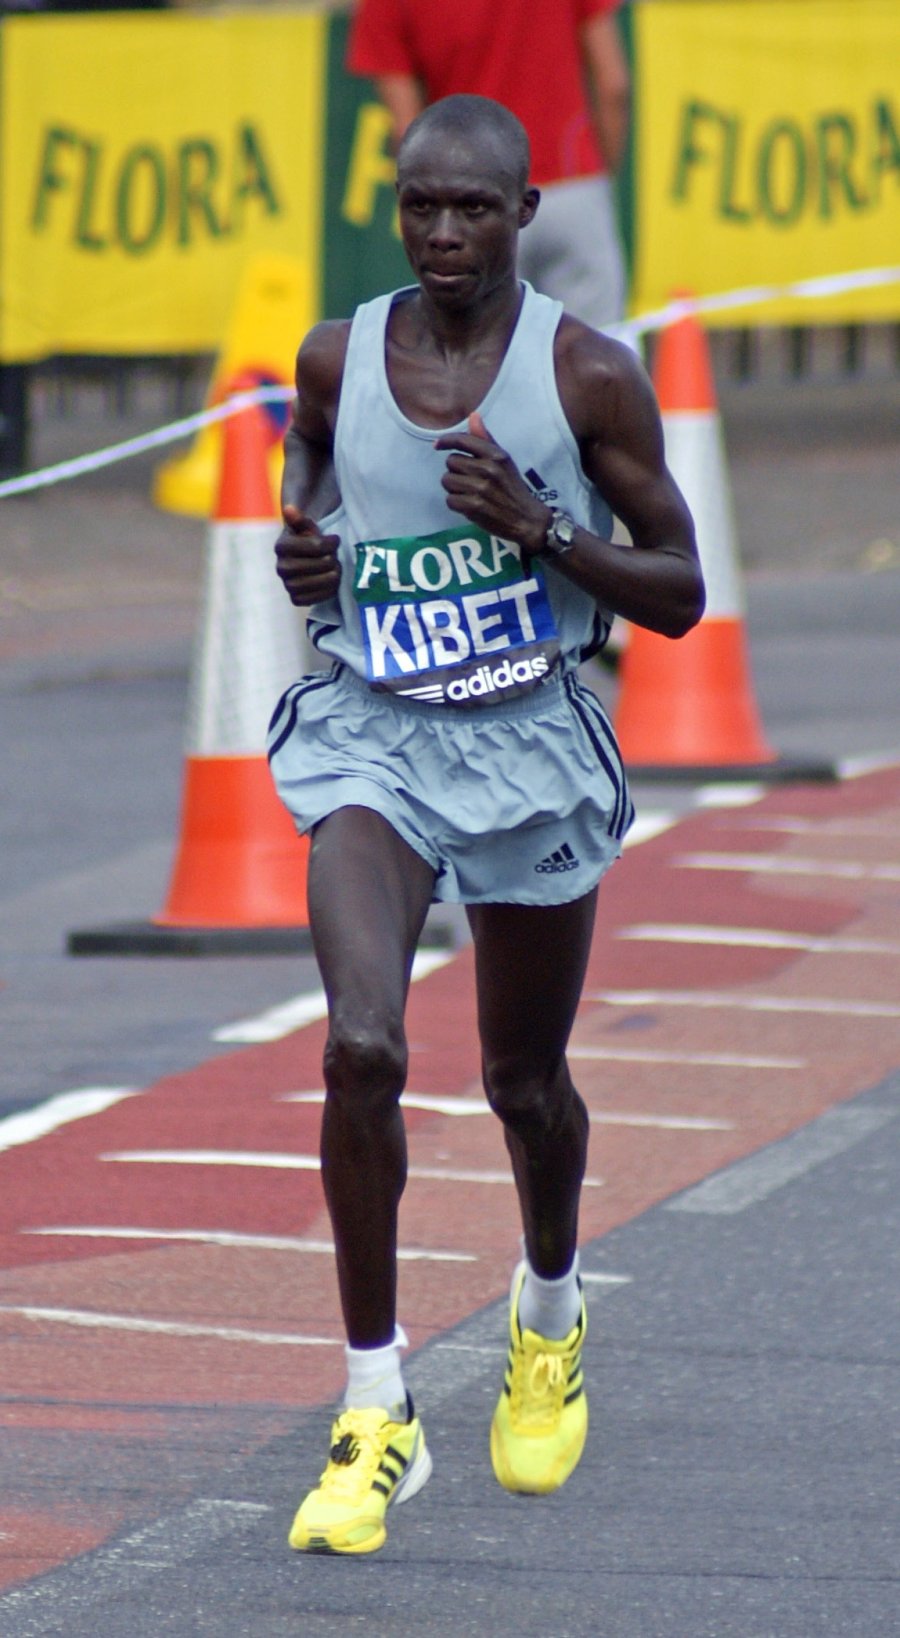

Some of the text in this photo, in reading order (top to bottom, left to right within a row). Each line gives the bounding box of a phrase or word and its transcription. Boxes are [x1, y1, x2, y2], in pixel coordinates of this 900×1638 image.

[31, 119, 285, 257] FLORA
[670, 94, 900, 228] FLORA
[357, 535, 521, 593] FLORA
[365, 578, 539, 678] KIBET
[447, 655, 549, 701] adidas
